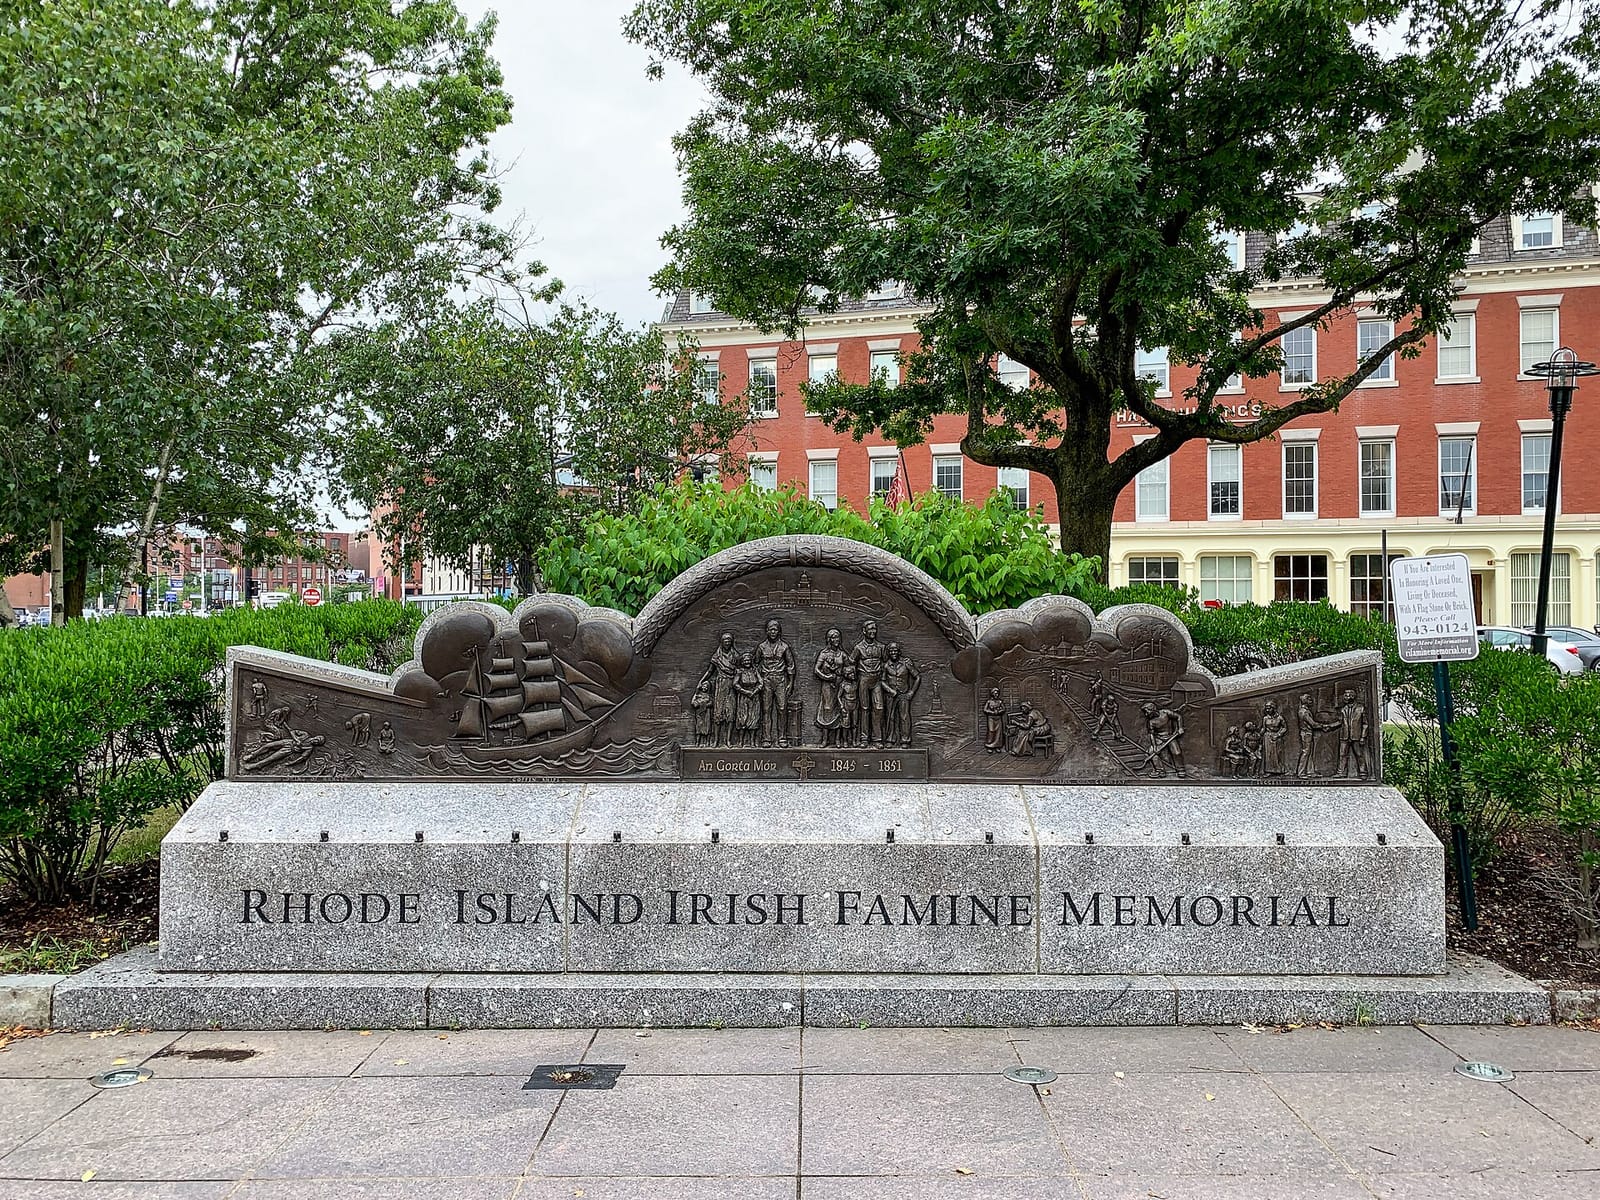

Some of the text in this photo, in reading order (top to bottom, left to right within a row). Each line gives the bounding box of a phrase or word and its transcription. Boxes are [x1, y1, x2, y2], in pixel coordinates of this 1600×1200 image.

[1405, 576, 1429, 587] Honoring
[1435, 575, 1450, 585] Loved
[1407, 590, 1424, 601] Living
[1399, 603, 1412, 614] With
[1429, 602, 1444, 612] Stone
[1414, 613, 1456, 623] Please Call
[1403, 622, 1469, 635] 943-0124
[1434, 638, 1469, 646] Information
[1405, 645, 1472, 657] rifaminememorial.org
[699, 760, 713, 772] An
[830, 759, 856, 772] 1845
[878, 759, 903, 772] 1851
[238, 889, 1351, 927] RHODE ISLAND IRISH FAMINE MEMORIAL
